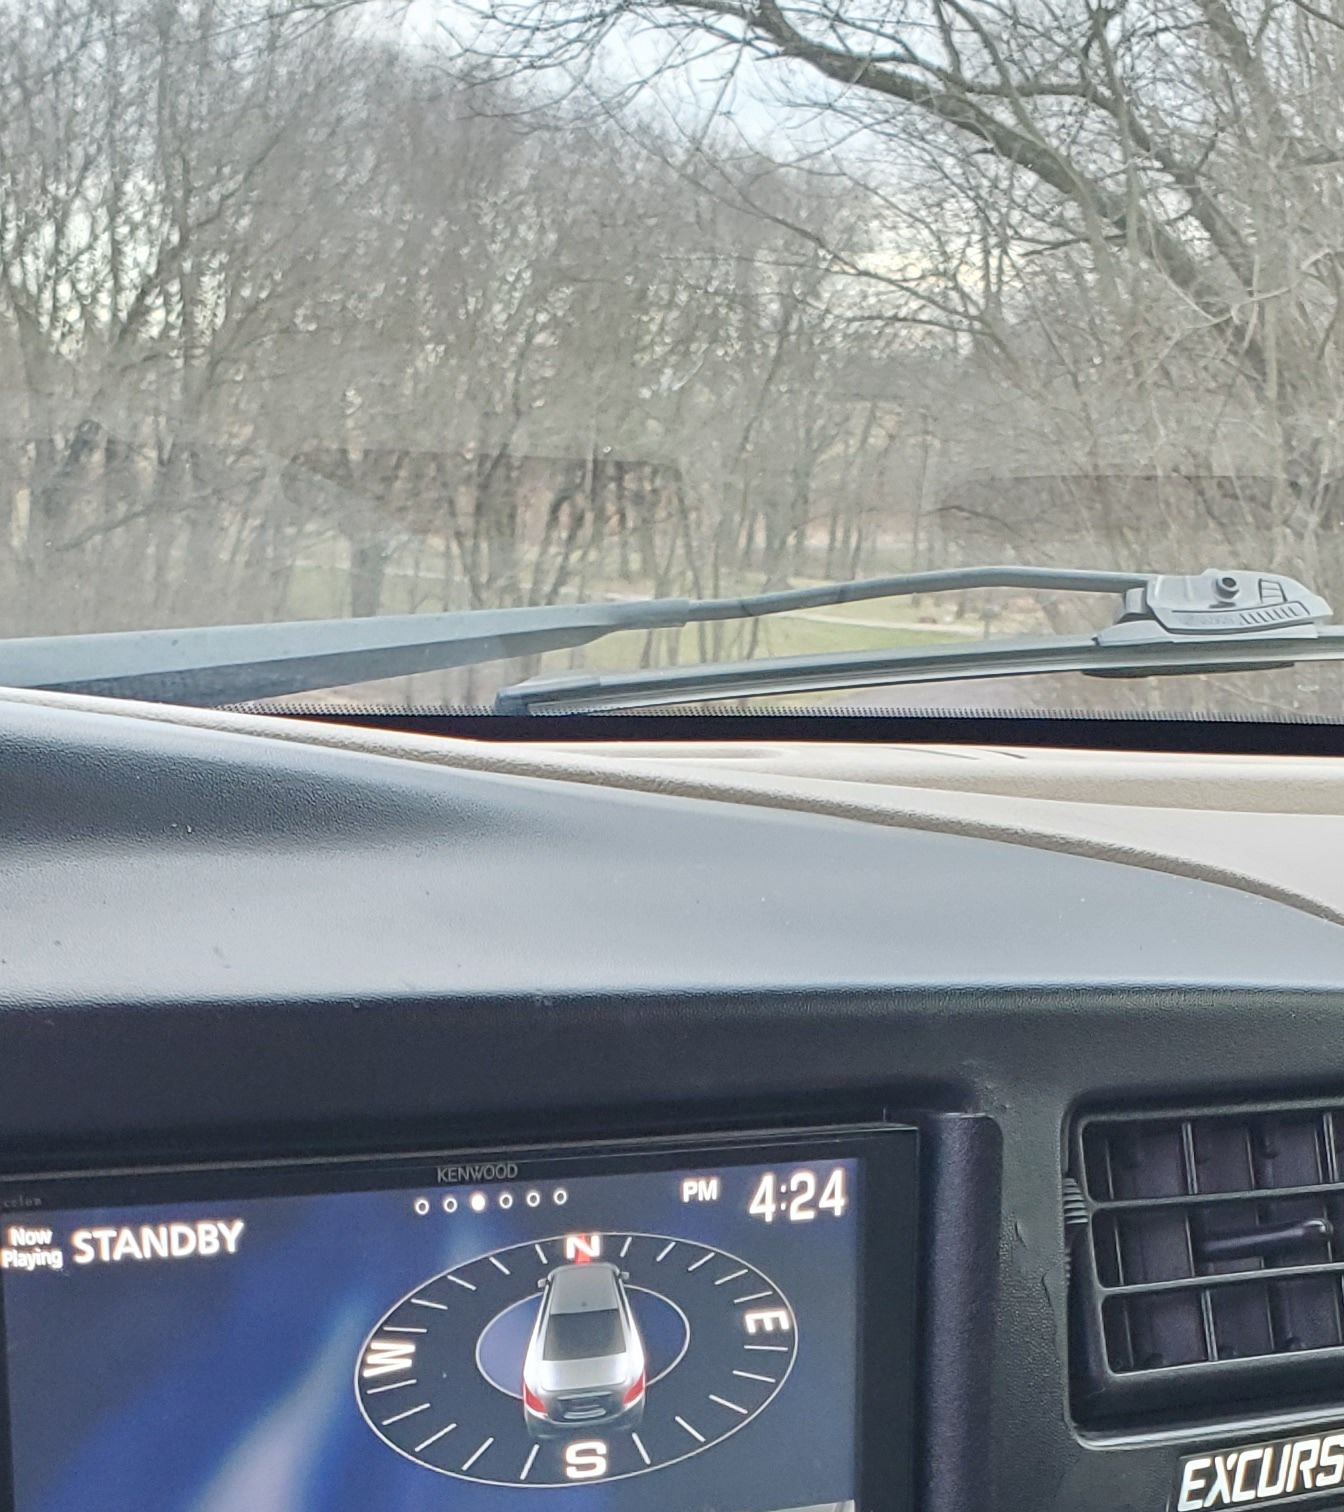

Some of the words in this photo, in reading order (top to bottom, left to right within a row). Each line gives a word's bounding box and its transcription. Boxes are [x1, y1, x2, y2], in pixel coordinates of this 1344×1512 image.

[437, 1164, 518, 1183] KENWOOD
[682, 1178, 720, 1202] PM
[748, 1168, 846, 1222] 4:24
[9, 1227, 53, 1246] Now
[72, 1220, 244, 1264] STANDBY
[565, 1236, 600, 1258] N
[1, 1247, 63, 1270] Playing
[745, 1310, 790, 1335] E
[363, 1341, 416, 1378] W
[565, 1440, 608, 1480] S
